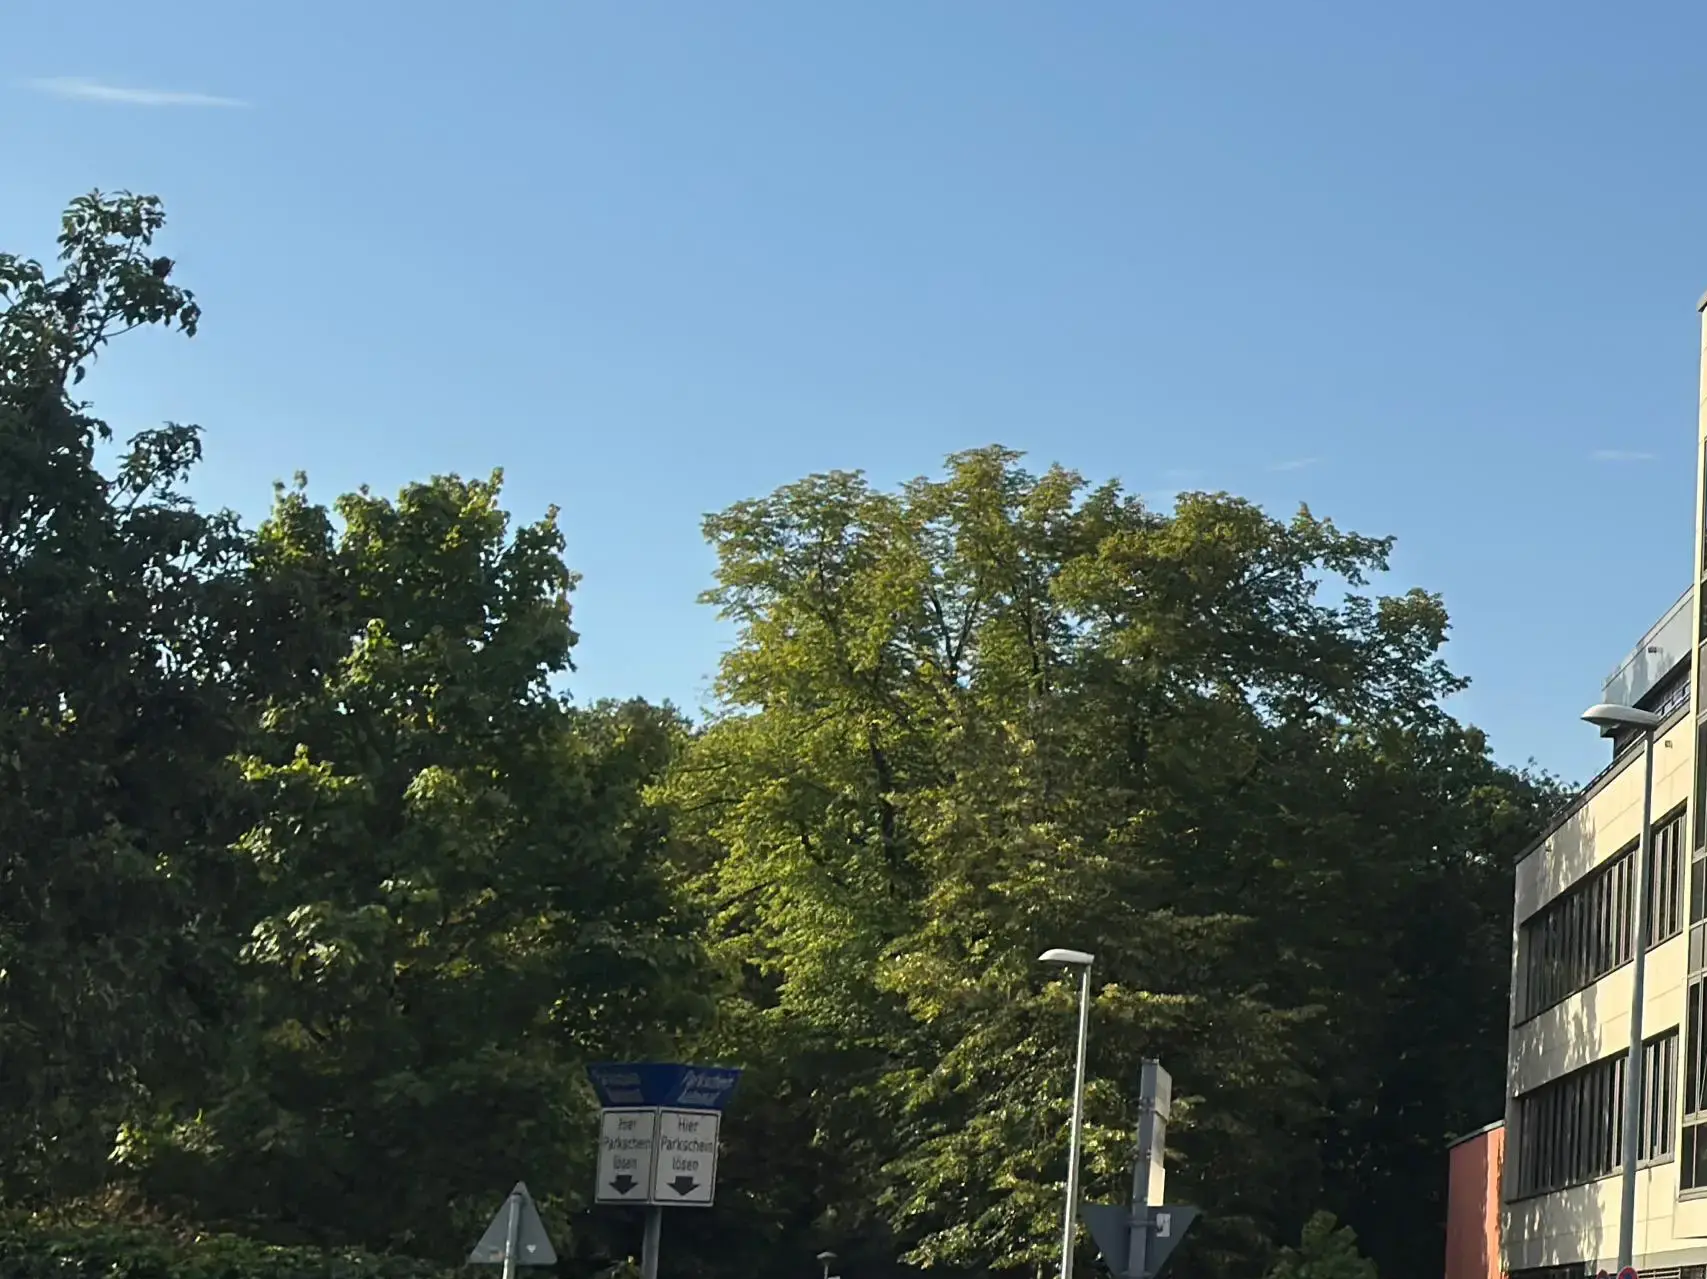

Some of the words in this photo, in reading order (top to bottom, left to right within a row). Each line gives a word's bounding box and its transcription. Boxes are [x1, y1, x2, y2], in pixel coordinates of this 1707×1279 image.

[678, 1116, 699, 1133] Hier
[660, 1136, 713, 1153] Parkschein
[672, 1155, 699, 1171] lösen
